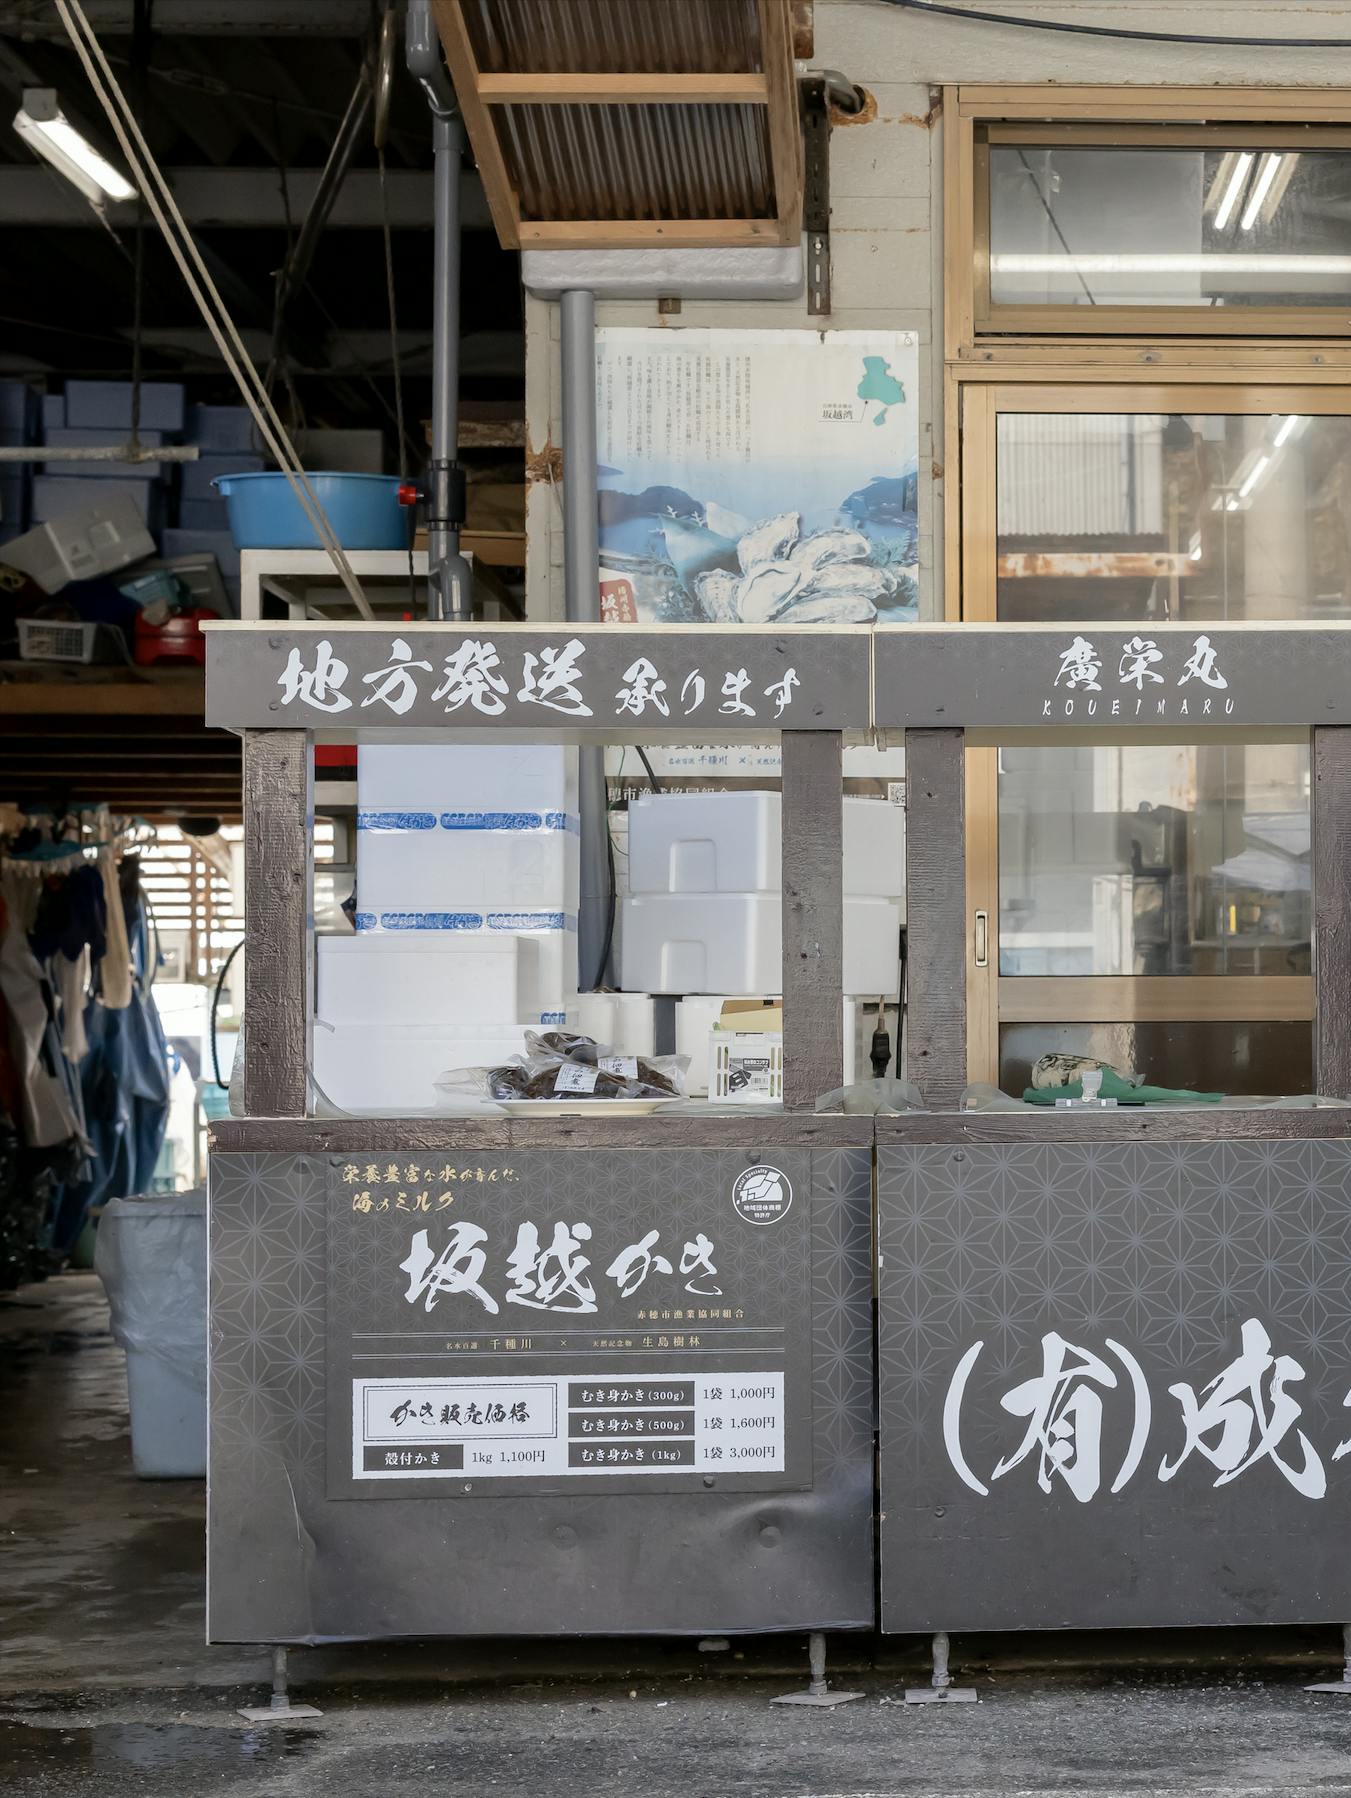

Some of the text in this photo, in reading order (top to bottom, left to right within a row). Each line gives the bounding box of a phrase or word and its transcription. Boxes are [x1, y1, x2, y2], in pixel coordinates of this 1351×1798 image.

[1054, 635, 1228, 691] 廣栄丸
[278, 639, 800, 718] 地方発送 承ります
[1043, 698, 1234, 716] KOUEIMARU
[352, 1191, 455, 1213] 海のミルク
[399, 1221, 723, 1315] 坂越かき
[637, 1308, 746, 1321] 赤穂市漁業協同組合
[703, 1387, 722, 1400] 1袋
[730, 1386, 775, 1400] 1,000円
[389, 1399, 530, 1427] かき販売価格
[703, 1416, 722, 1430] 1袋
[730, 1416, 775, 1429] 1,600円
[384, 1449, 546, 1466] 殻付かき 1kg 1,100円
[703, 1446, 722, 1459] 1袋
[729, 1446, 775, 1459] 3,000円
